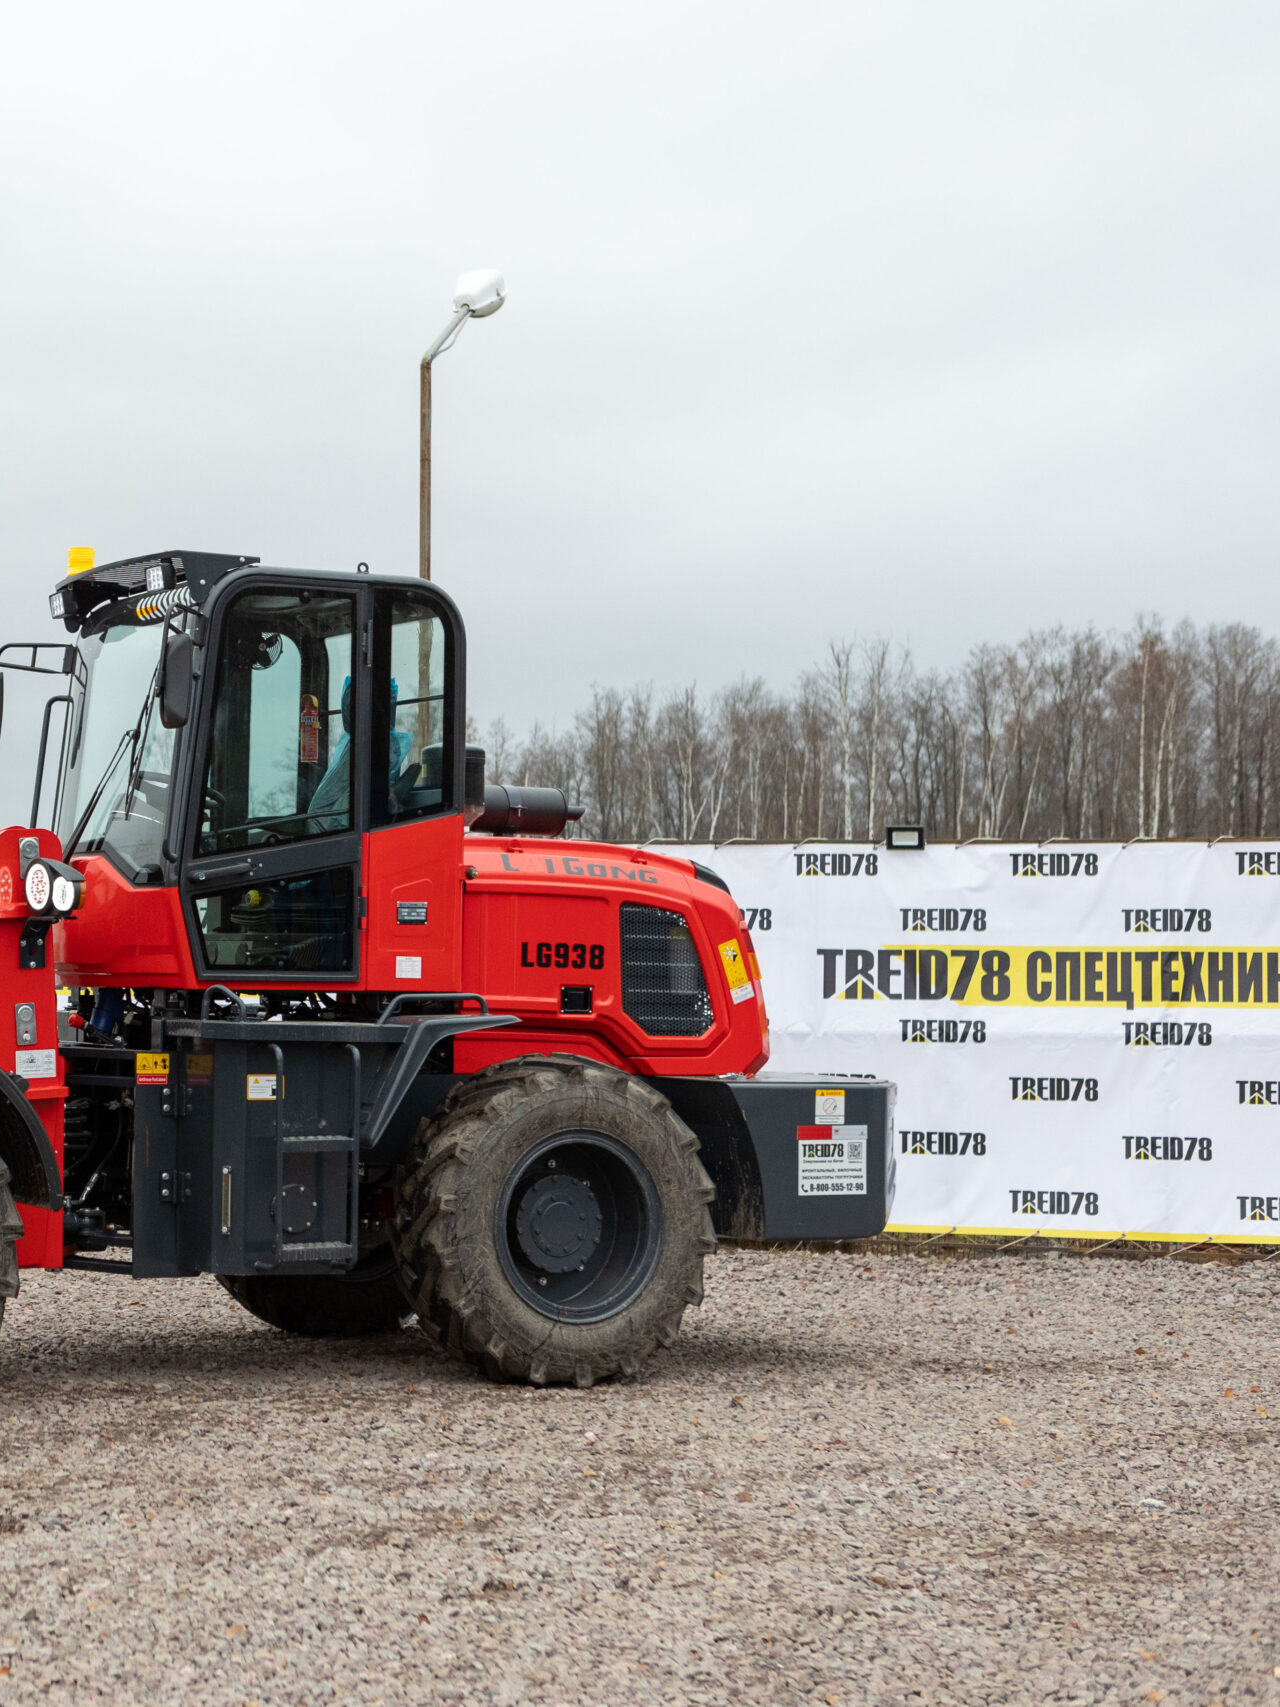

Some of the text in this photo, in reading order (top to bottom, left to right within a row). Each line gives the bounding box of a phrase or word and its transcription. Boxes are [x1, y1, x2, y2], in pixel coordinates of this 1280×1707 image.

[794, 853, 878, 876] TREID78
[1010, 853, 1098, 876] TREID78
[900, 909, 986, 931] TREID78
[1122, 909, 1211, 932] TREID78
[521, 942, 604, 969] LG938
[817, 949, 1010, 1001] TREID78
[899, 1020, 986, 1043] TREID78
[1122, 1023, 1212, 1046] TREID78
[1009, 1077, 1098, 1101] TREID78
[802, 1144, 844, 1157] TREID78
[899, 1131, 986, 1155] TREID78
[1122, 1136, 1212, 1161] TREID78
[1009, 1190, 1098, 1215] TREID78
